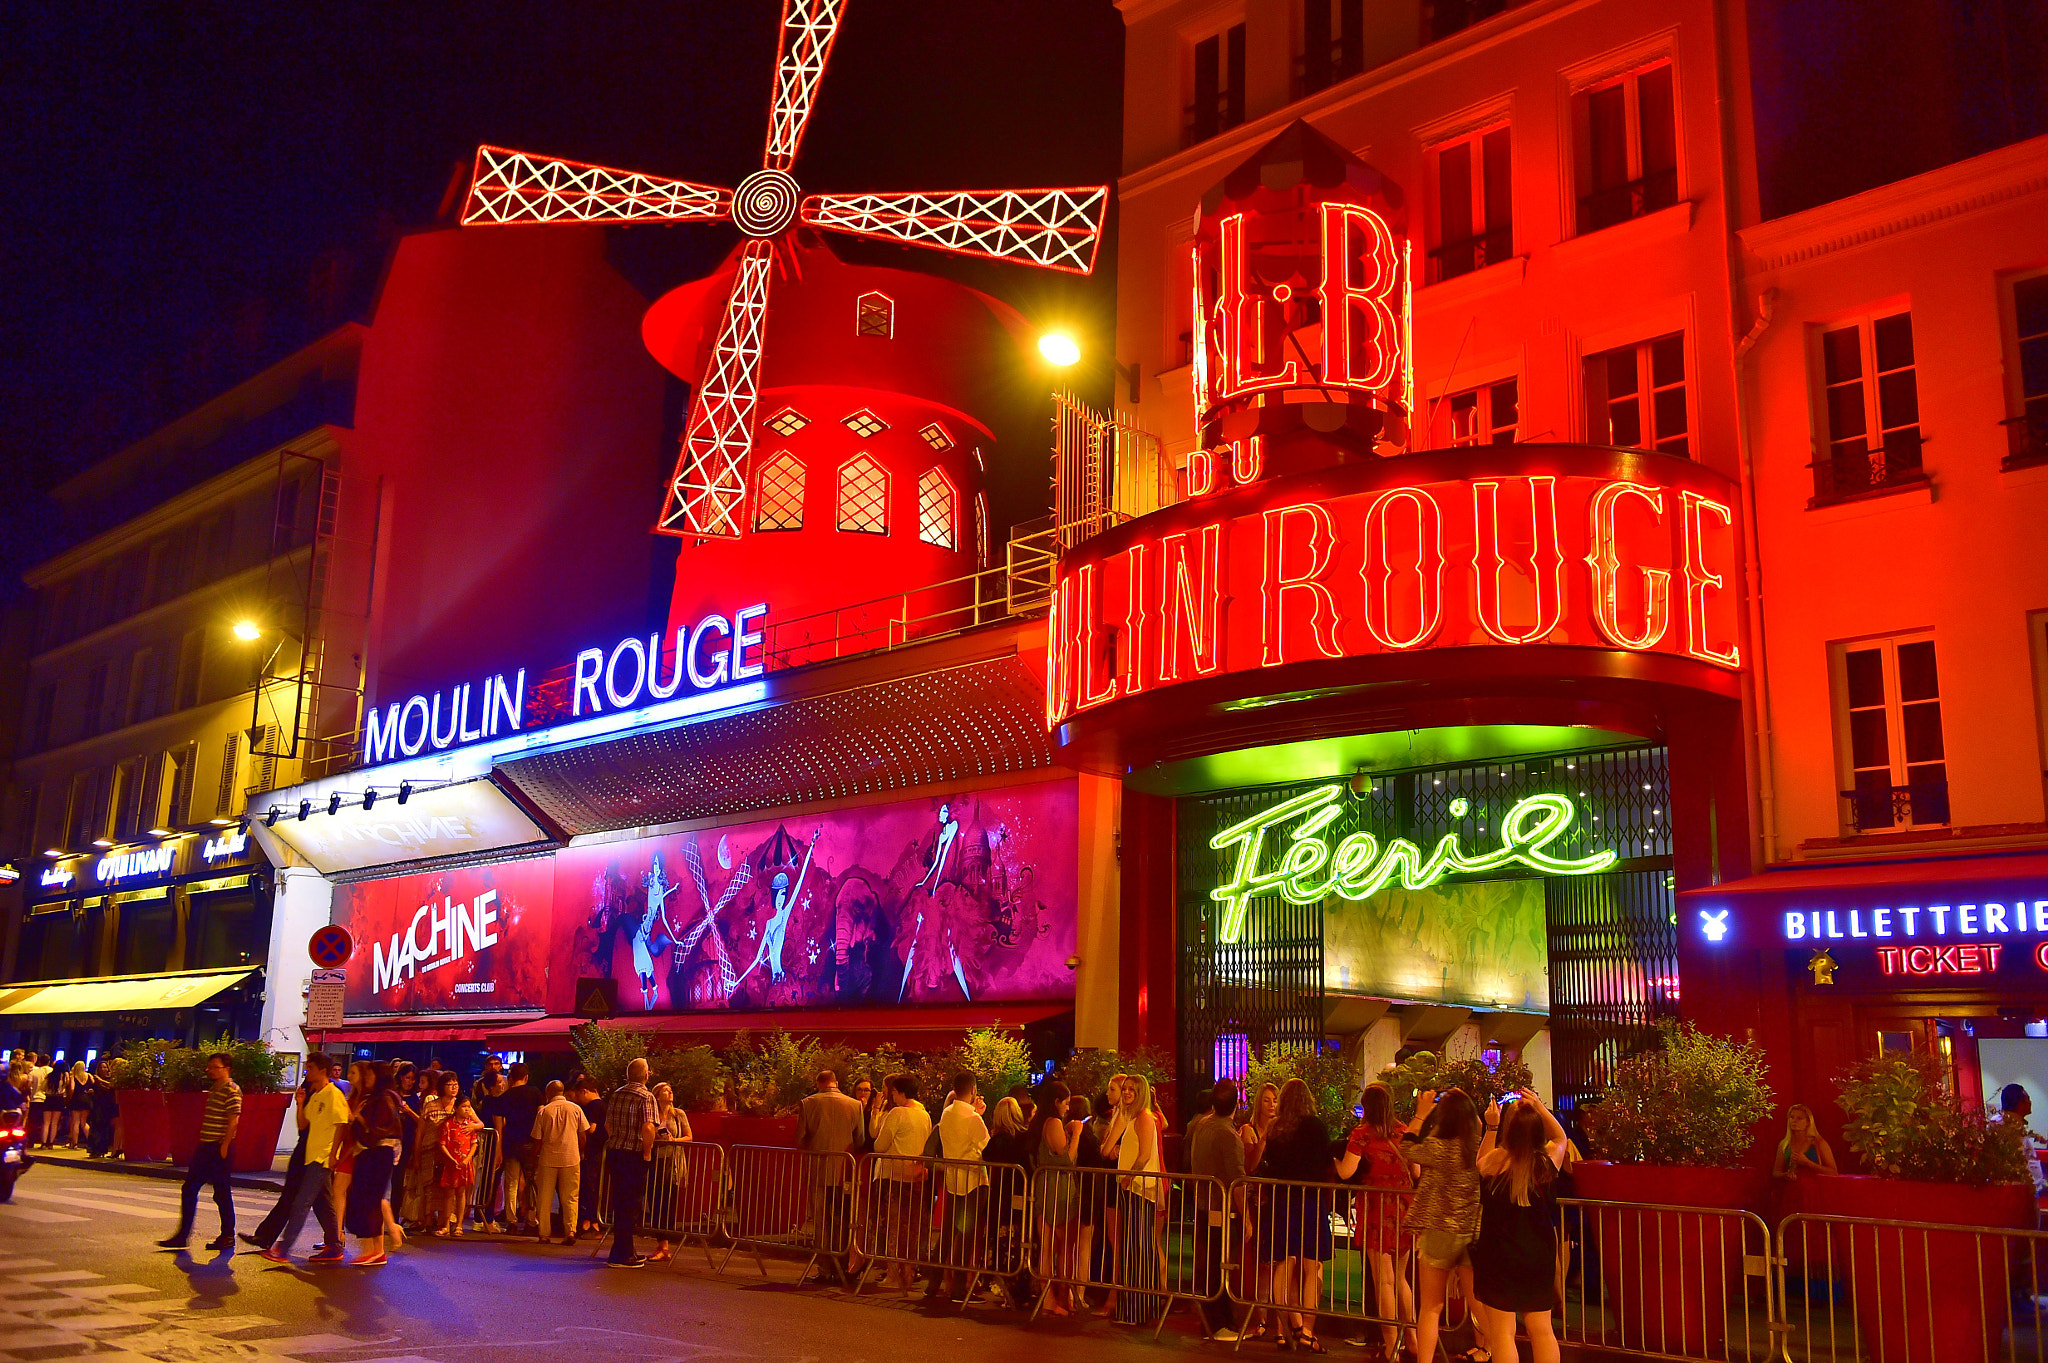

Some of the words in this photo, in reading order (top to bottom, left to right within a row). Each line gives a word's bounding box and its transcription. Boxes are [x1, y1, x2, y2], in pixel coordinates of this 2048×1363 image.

[1188, 436, 1260, 496] DU
[1262, 475, 1740, 671] ROUGE
[363, 668, 526, 765] MOULIN
[572, 603, 768, 716] ROUGE
[1210, 784, 1617, 944] Féerie
[373, 888, 498, 994] MACHINE
[1786, 902, 2048, 940] BILLETTERIE
[1877, 944, 2003, 975] TICKET
[454, 983, 481, 993] CONCERTS
[481, 982, 495, 993] CLUB
